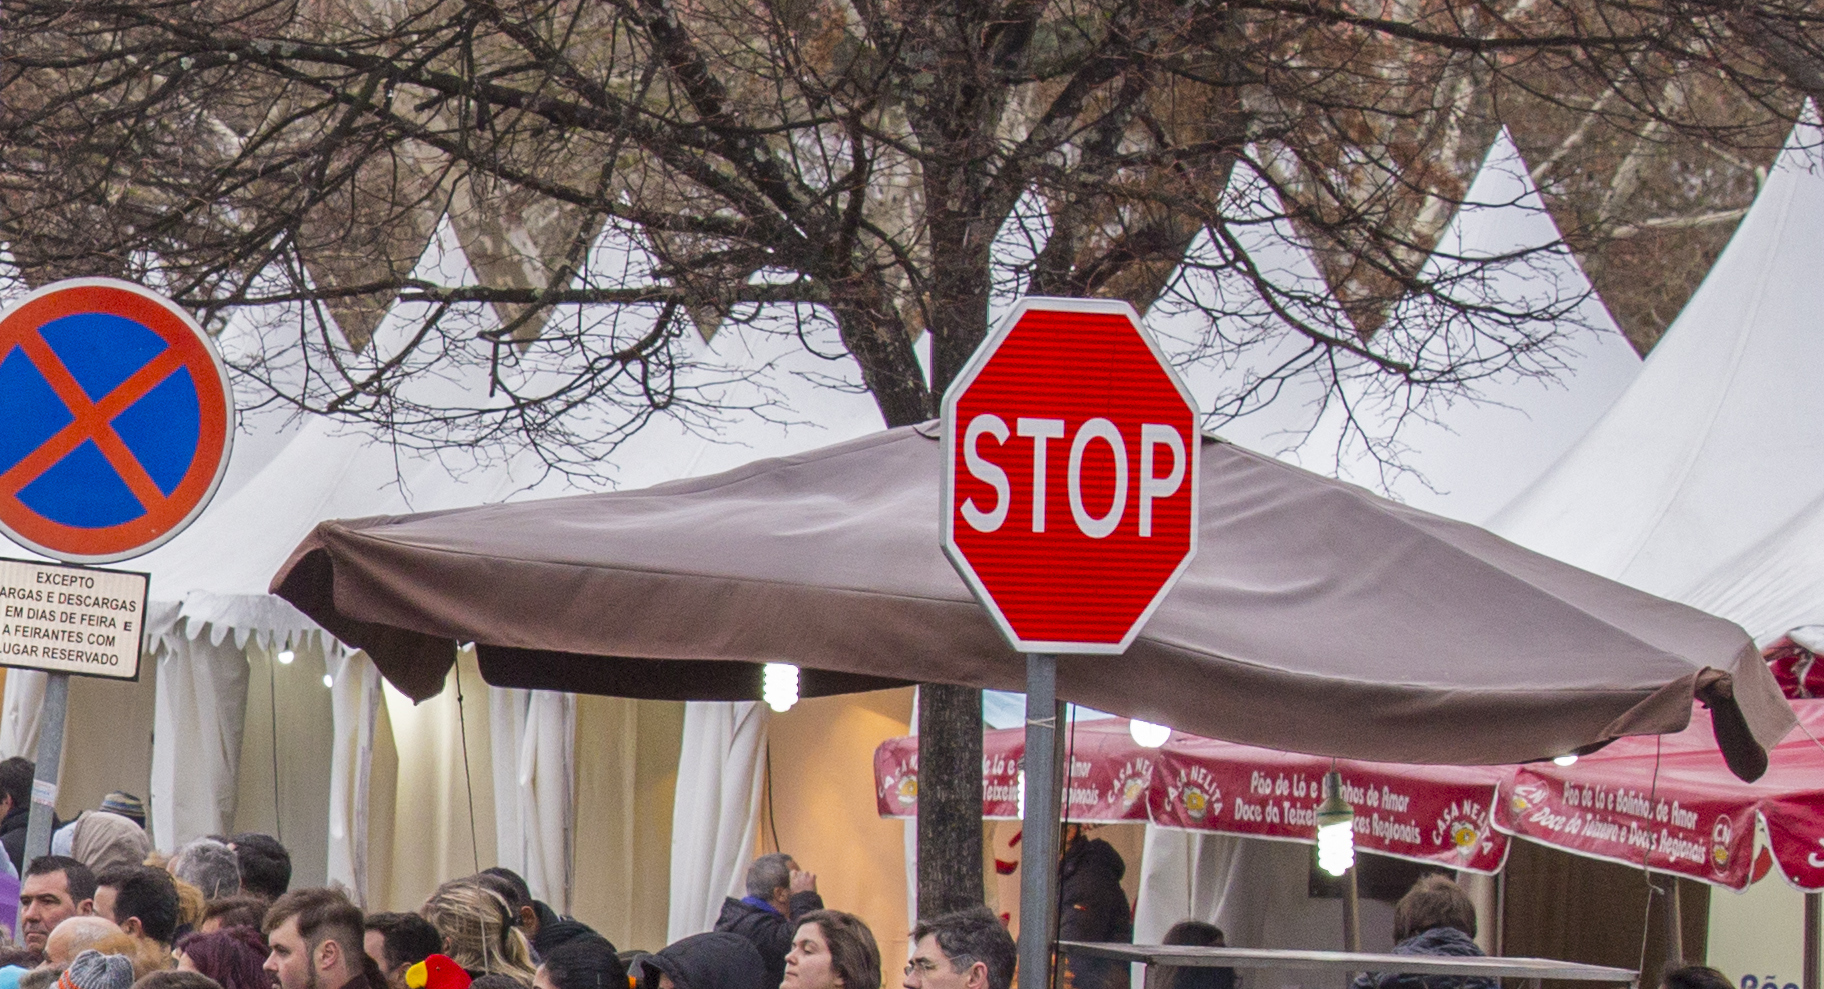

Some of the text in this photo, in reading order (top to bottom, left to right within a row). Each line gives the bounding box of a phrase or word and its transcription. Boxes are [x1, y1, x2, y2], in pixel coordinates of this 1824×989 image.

[959, 413, 1187, 539] STOP
[36, 571, 94, 589] EXCEPTO
[47, 591, 55, 603] E
[58, 592, 137, 613] DESCARGAS
[2, 624, 116, 647] A FEIRANTES COM
[5, 605, 133, 632] EM DIAS DE FEIRA E
[42, 646, 119, 666] RESERVADO
[1164, 772, 1188, 812] CASA
[1190, 765, 1223, 816] NELITA
[1251, 771, 1273, 797] Pão
[1275, 774, 1291, 796] de
[1294, 774, 1307, 797] Ló
[1310, 782, 1318, 798] e
[1367, 784, 1380, 806] de
[1382, 786, 1409, 813] Amor
[1562, 781, 1579, 806] Pão
[1581, 783, 1593, 806] de
[1595, 784, 1605, 807] Ló
[1607, 794, 1614, 809] e
[1656, 798, 1669, 822] de
[1671, 801, 1698, 831] Amor
[1234, 798, 1263, 822] Doce
[1266, 801, 1280, 824] da
[1372, 818, 1421, 846] Regionais
[1432, 799, 1493, 855] CASA NELITA
[1530, 807, 1563, 831] Doce
[1582, 812, 1618, 842] Teixeira
[1619, 829, 1627, 844] e
[1659, 832, 1706, 865] Regionais
